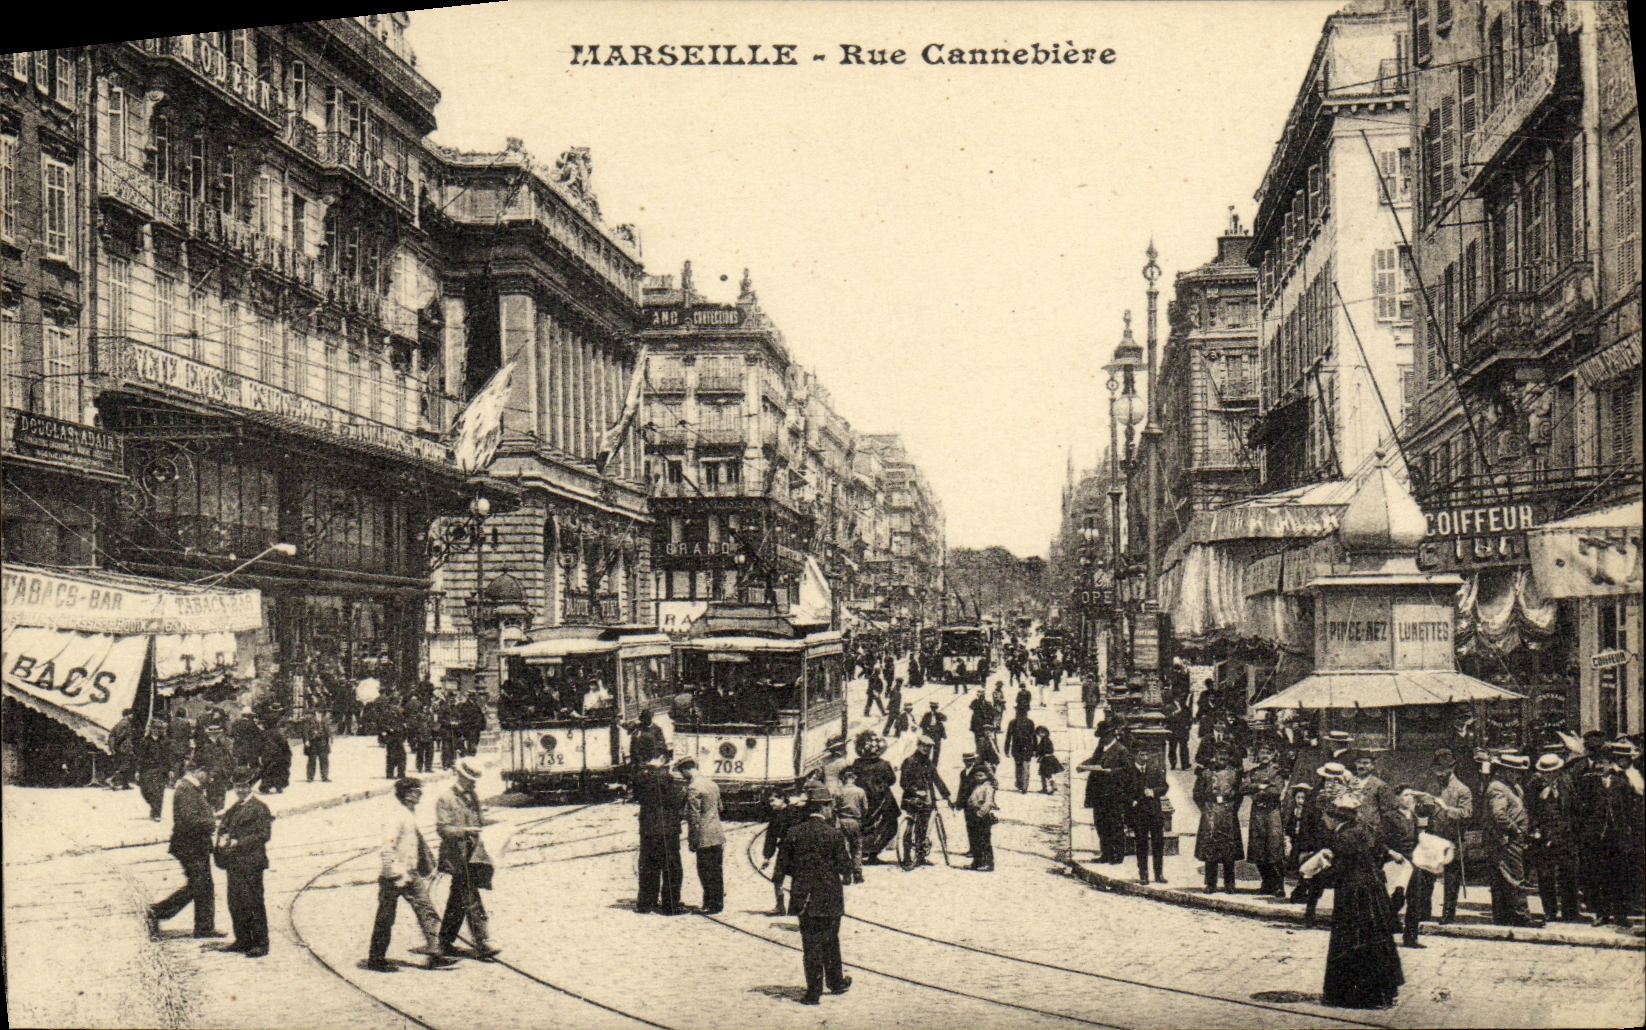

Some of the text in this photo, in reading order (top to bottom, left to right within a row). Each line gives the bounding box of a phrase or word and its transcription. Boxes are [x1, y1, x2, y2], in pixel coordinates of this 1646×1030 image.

[20, 414, 75, 443] DOUGLAS
[1424, 504, 1535, 537] COIFFEUR
[666, 541, 731, 555] GRAND
[3, 572, 123, 611] TABACS-BAR
[1329, 621, 1388, 642] PINCE-NEZ
[1398, 621, 1450, 642] LUNETTES
[2, 651, 117, 704] BACS
[713, 760, 745, 774] 708
